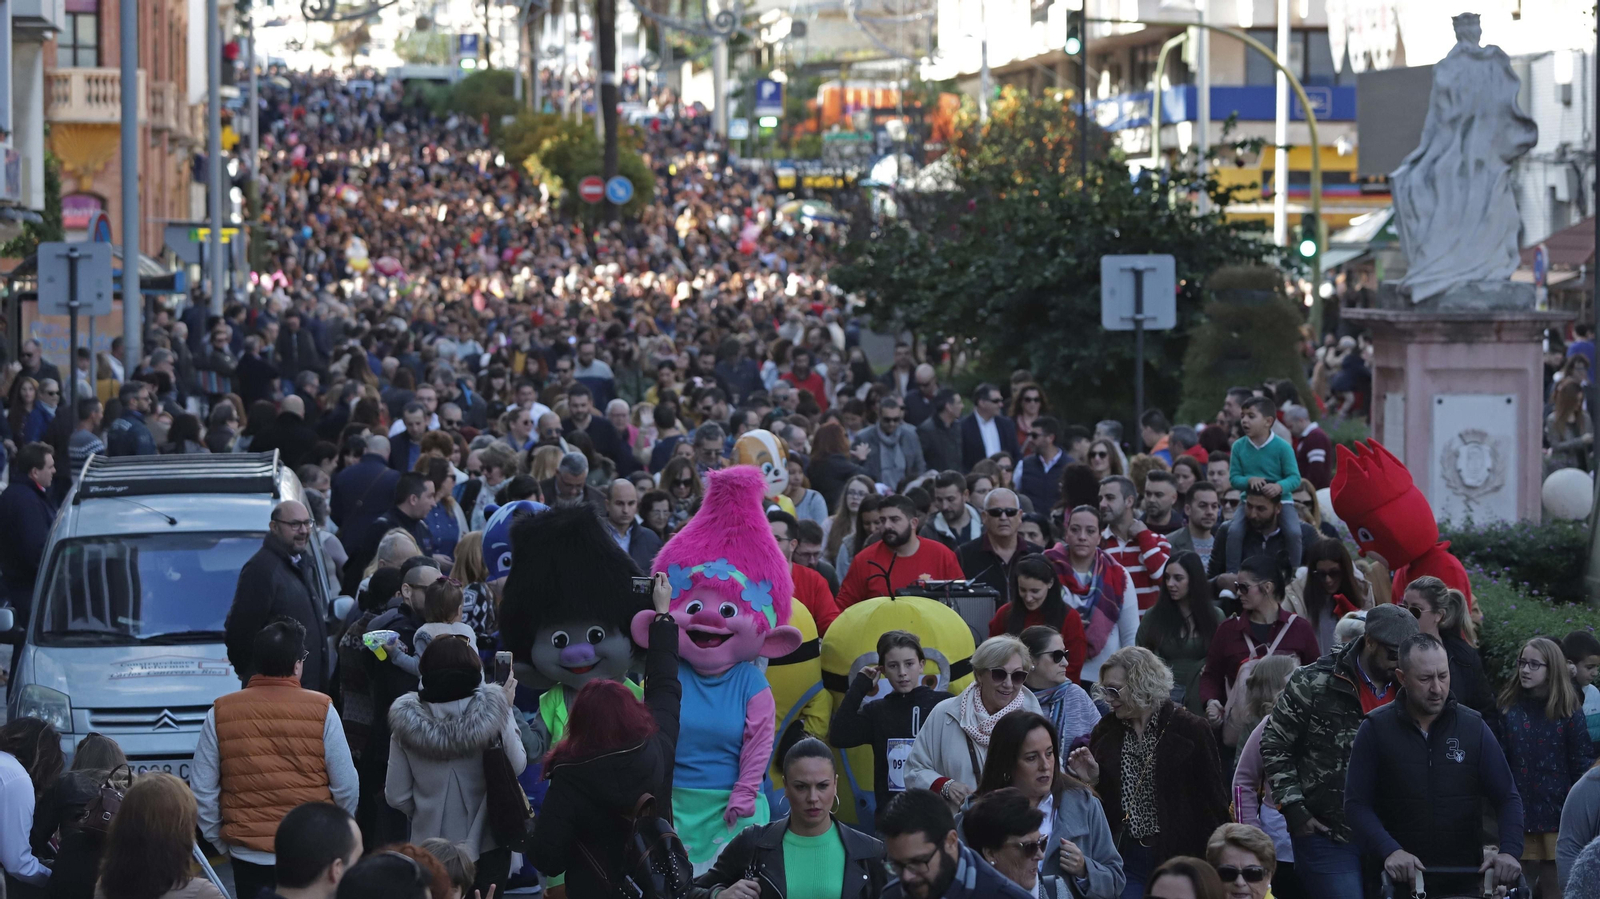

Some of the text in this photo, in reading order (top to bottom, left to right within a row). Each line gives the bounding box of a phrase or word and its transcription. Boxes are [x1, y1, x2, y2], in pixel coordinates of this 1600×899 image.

[761, 81, 776, 99] P
[120, 660, 195, 668] Construcciones
[893, 759, 906, 769] 09
